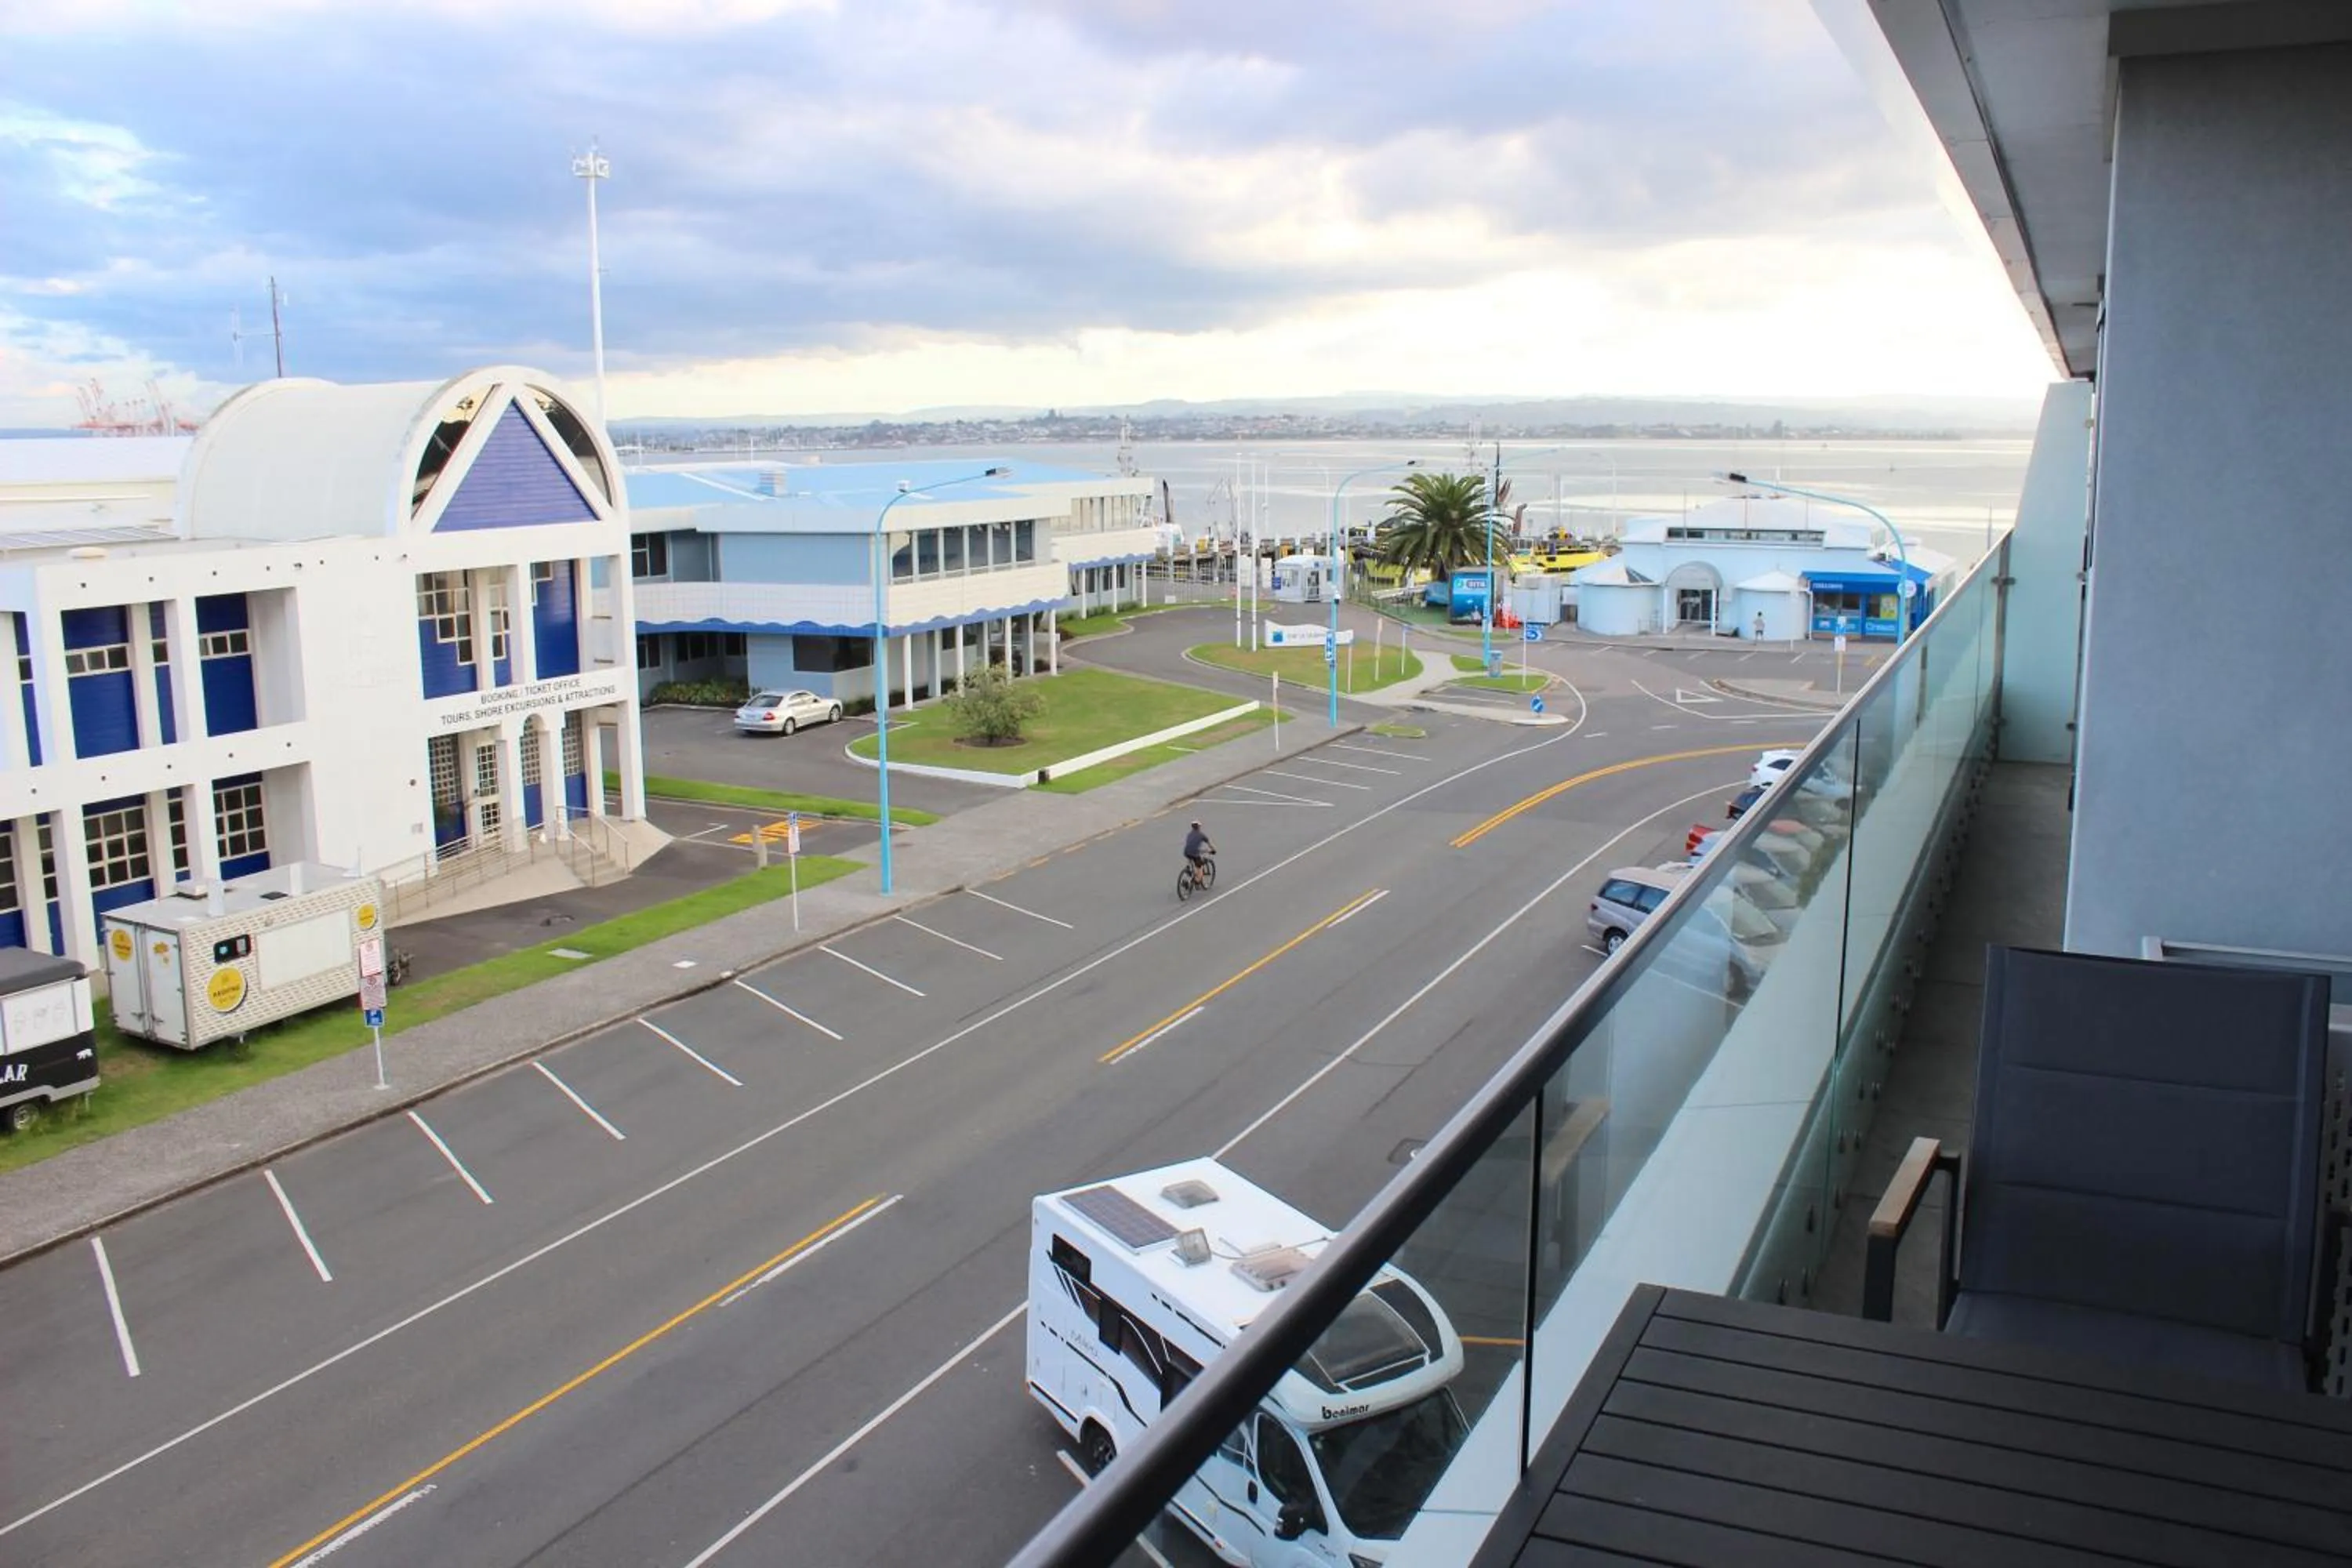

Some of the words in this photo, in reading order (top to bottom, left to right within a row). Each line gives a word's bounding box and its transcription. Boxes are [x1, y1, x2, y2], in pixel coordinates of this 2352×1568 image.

[474, 706, 503, 719] SHORE
[505, 695, 556, 713] EXCURSIONS
[557, 694, 563, 703] &
[565, 684, 615, 701] ATTRACTIONS
[481, 689, 518, 704] BOOKING
[525, 683, 552, 695] TICKET
[554, 679, 581, 691] OFFICE
[0, 1064, 28, 1083] AR
